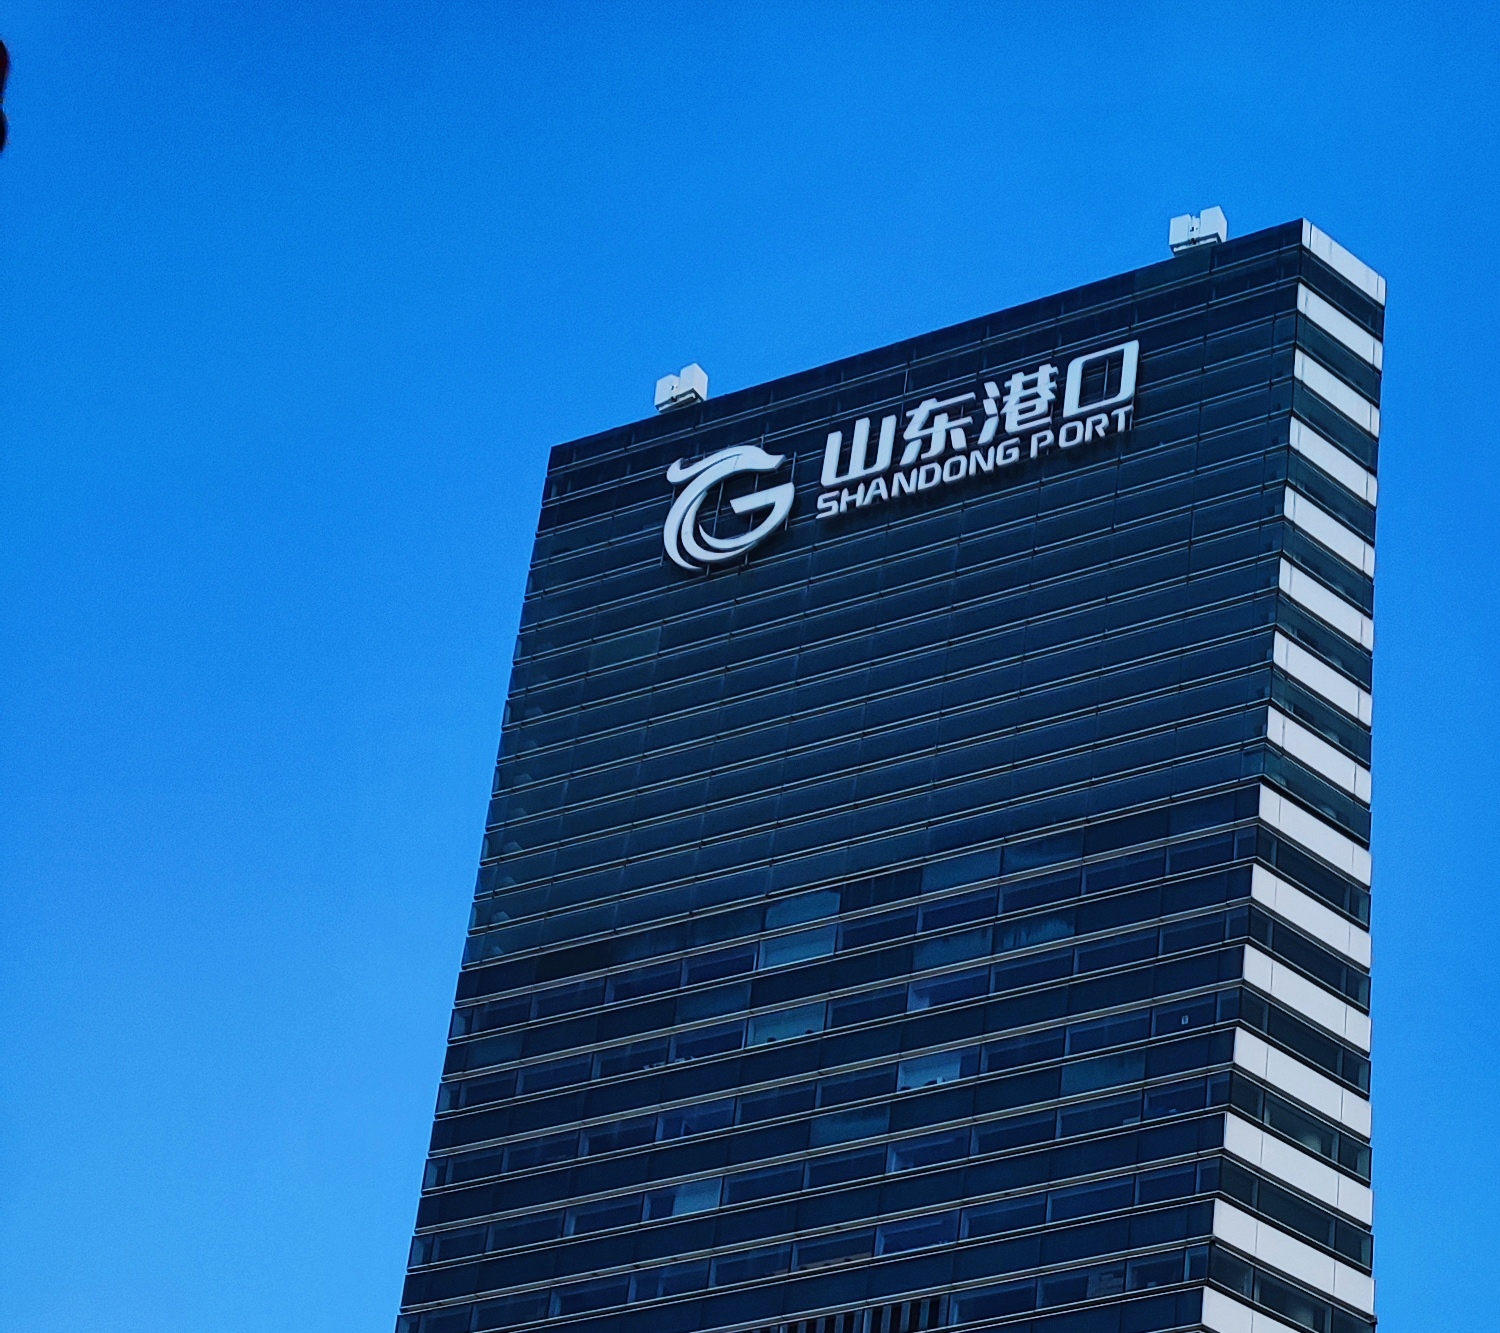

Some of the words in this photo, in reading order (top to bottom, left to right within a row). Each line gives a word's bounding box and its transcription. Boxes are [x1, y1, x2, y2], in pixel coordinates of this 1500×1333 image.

[815, 437, 1022, 520] SHANDONG
[1030, 404, 1135, 459] PORT
[821, 339, 1140, 488] 山东港口
